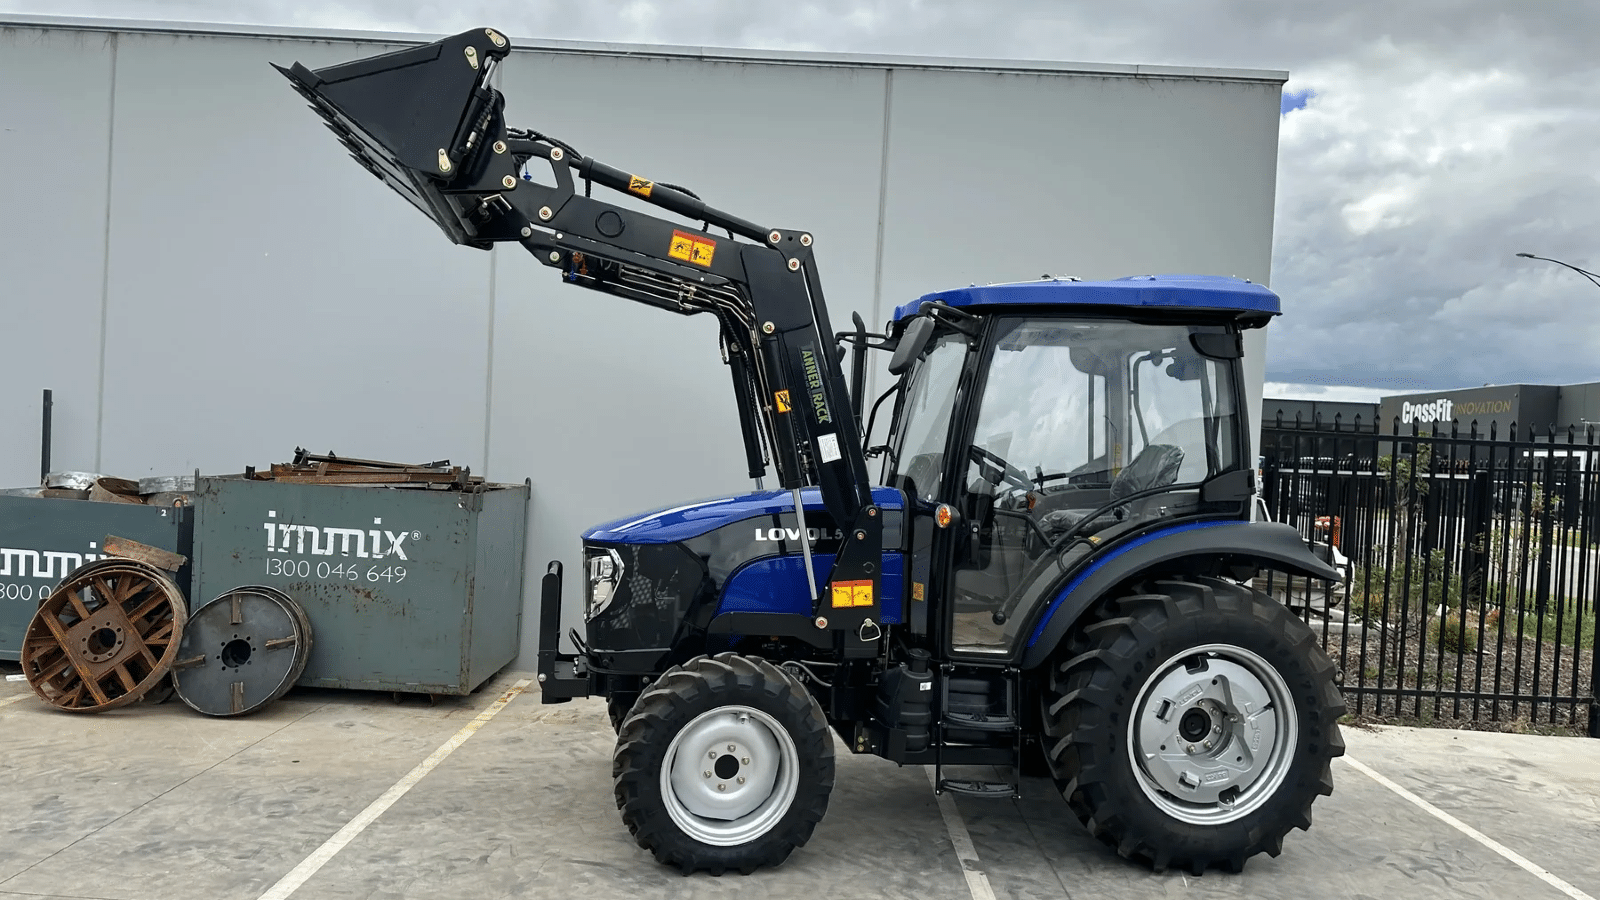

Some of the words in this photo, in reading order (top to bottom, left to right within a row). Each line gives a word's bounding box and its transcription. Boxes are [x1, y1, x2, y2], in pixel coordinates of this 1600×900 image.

[1402, 398, 1453, 424] CrossFit
[266, 558, 310, 578] 1300
[316, 561, 359, 581] 046
[366, 565, 407, 583] 649
